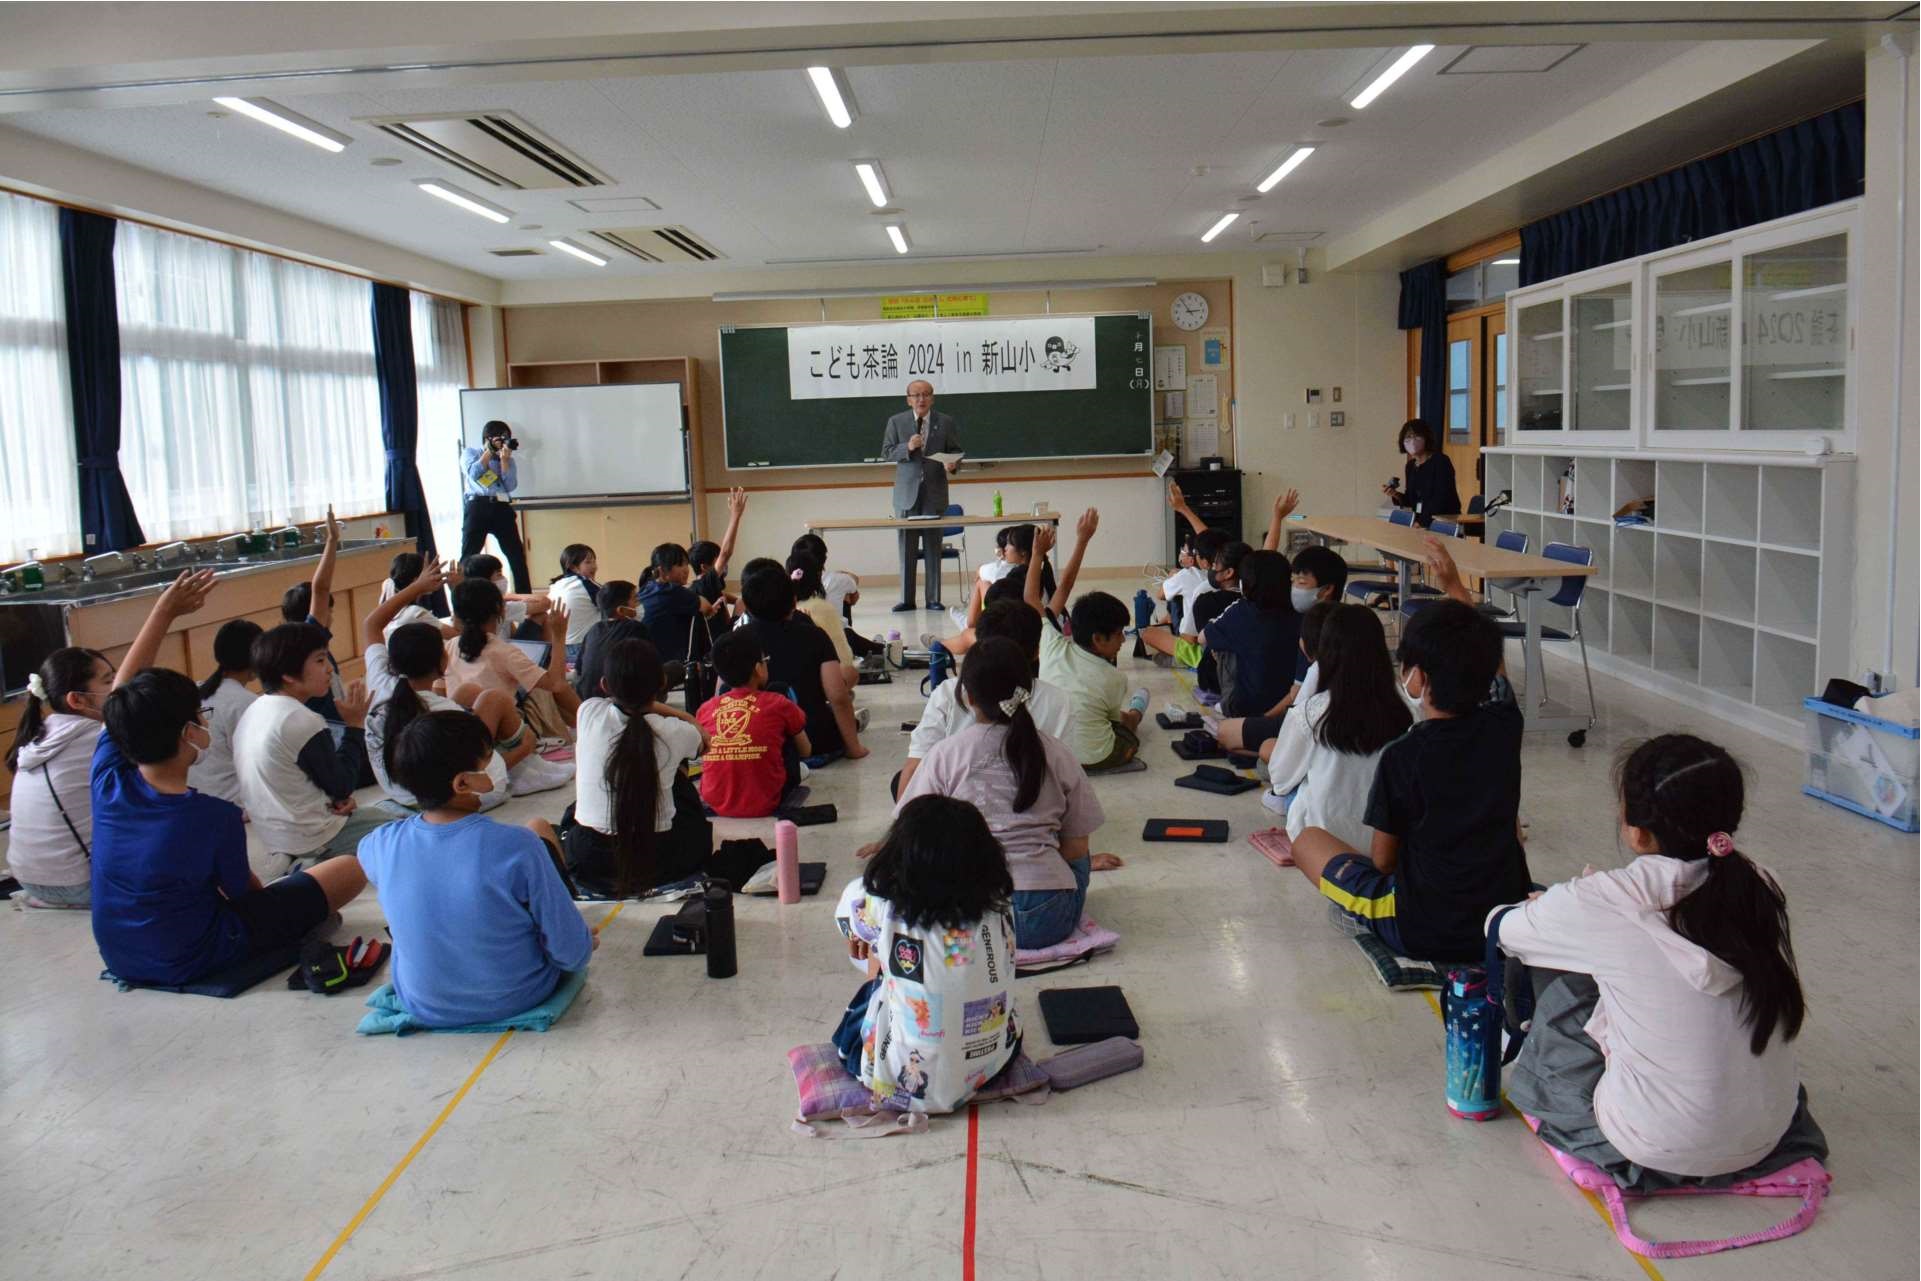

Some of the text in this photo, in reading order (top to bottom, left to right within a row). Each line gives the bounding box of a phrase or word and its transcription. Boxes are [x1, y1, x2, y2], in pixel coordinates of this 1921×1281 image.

[810, 340, 1035, 379] こども茶論 2024 in 新山小
[982, 925, 998, 983] GENEROUS
